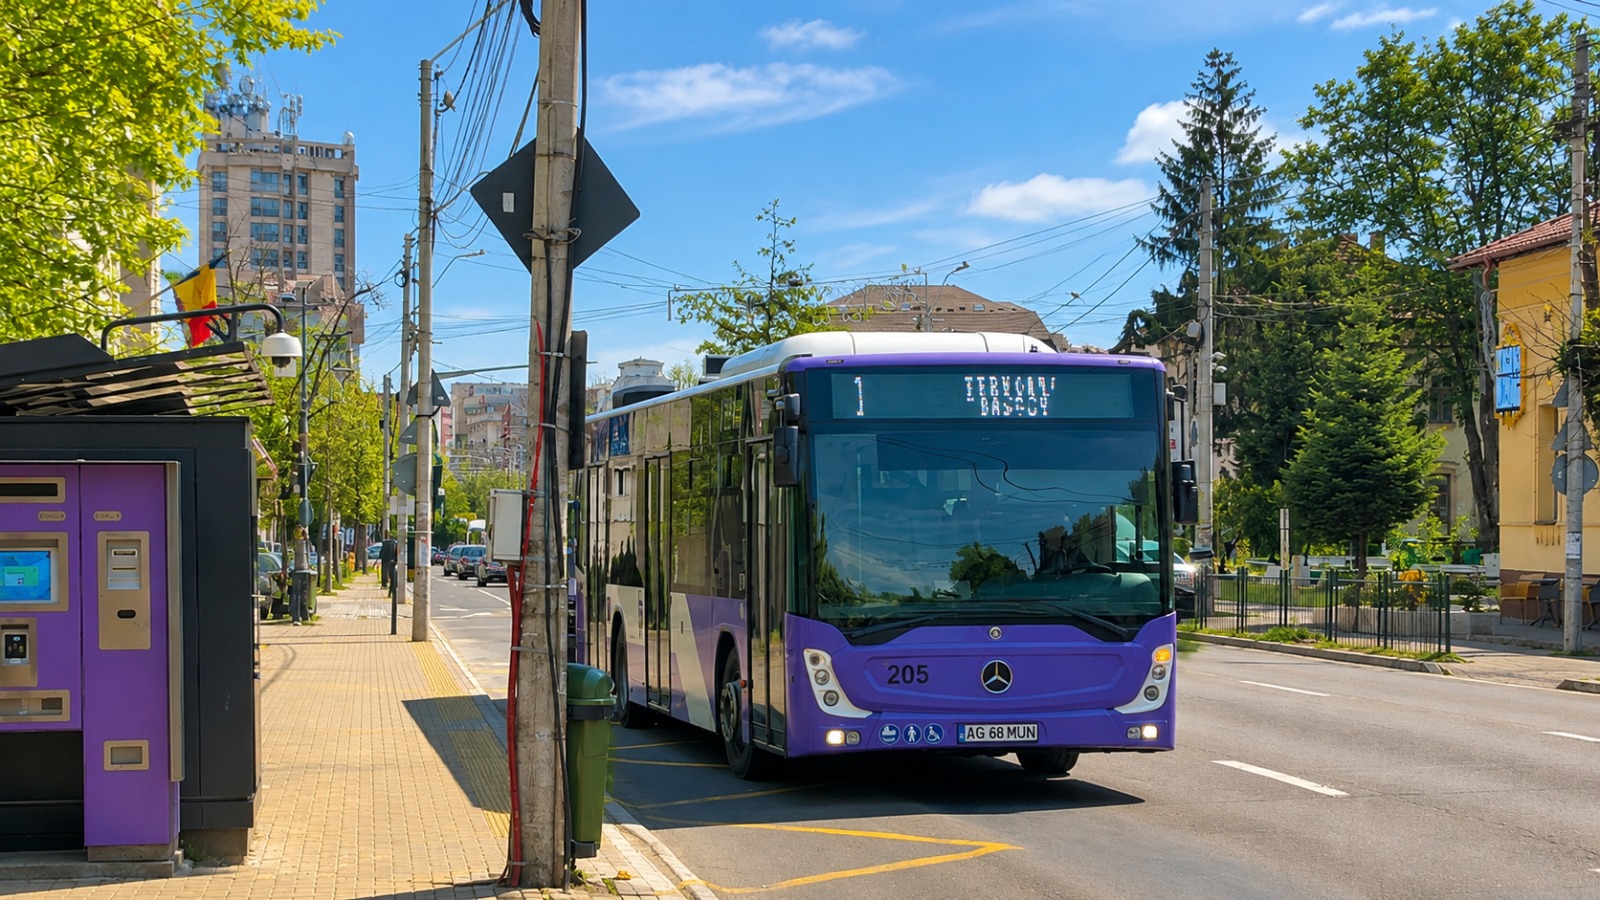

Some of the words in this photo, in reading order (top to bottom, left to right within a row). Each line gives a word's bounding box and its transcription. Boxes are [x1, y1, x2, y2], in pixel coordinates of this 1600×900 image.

[854, 376, 864, 416] 1
[887, 664, 929, 685] 205
[966, 726, 985, 740] AG
[989, 726, 1004, 740] 68
[1007, 725, 1036, 740] MUN
